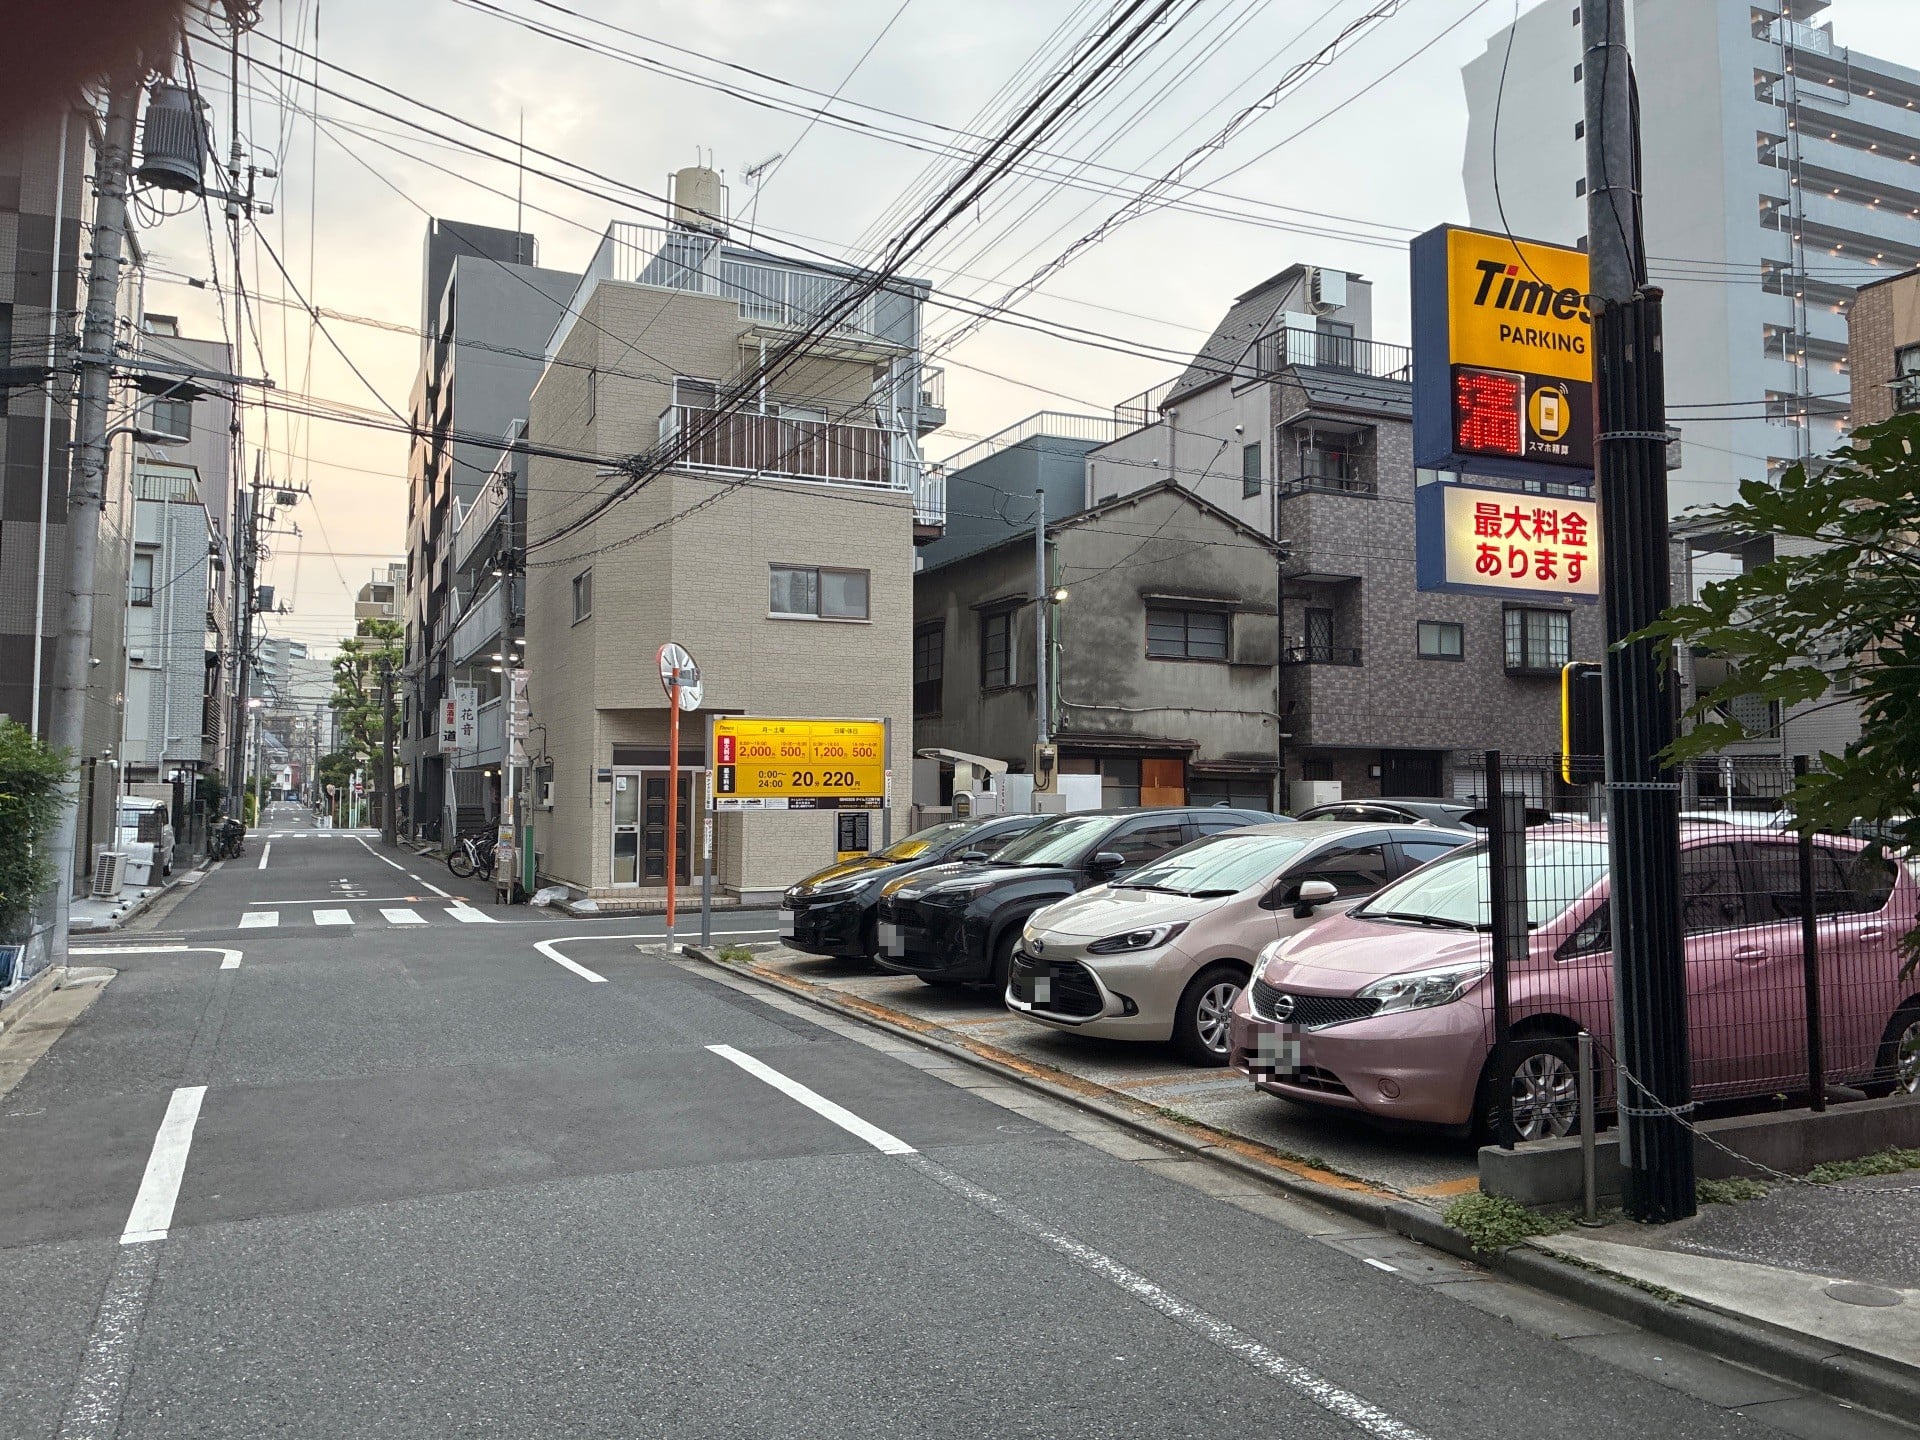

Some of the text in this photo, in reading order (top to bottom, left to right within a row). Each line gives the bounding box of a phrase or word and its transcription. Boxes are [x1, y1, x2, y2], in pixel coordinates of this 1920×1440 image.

[1500, 325, 1585, 354] PARKING
[1529, 442, 1569, 456] スマホ精算
[1474, 502, 1588, 547] 最大料金
[1475, 542, 1588, 584] あります
[758, 780, 782, 788] 24:00
